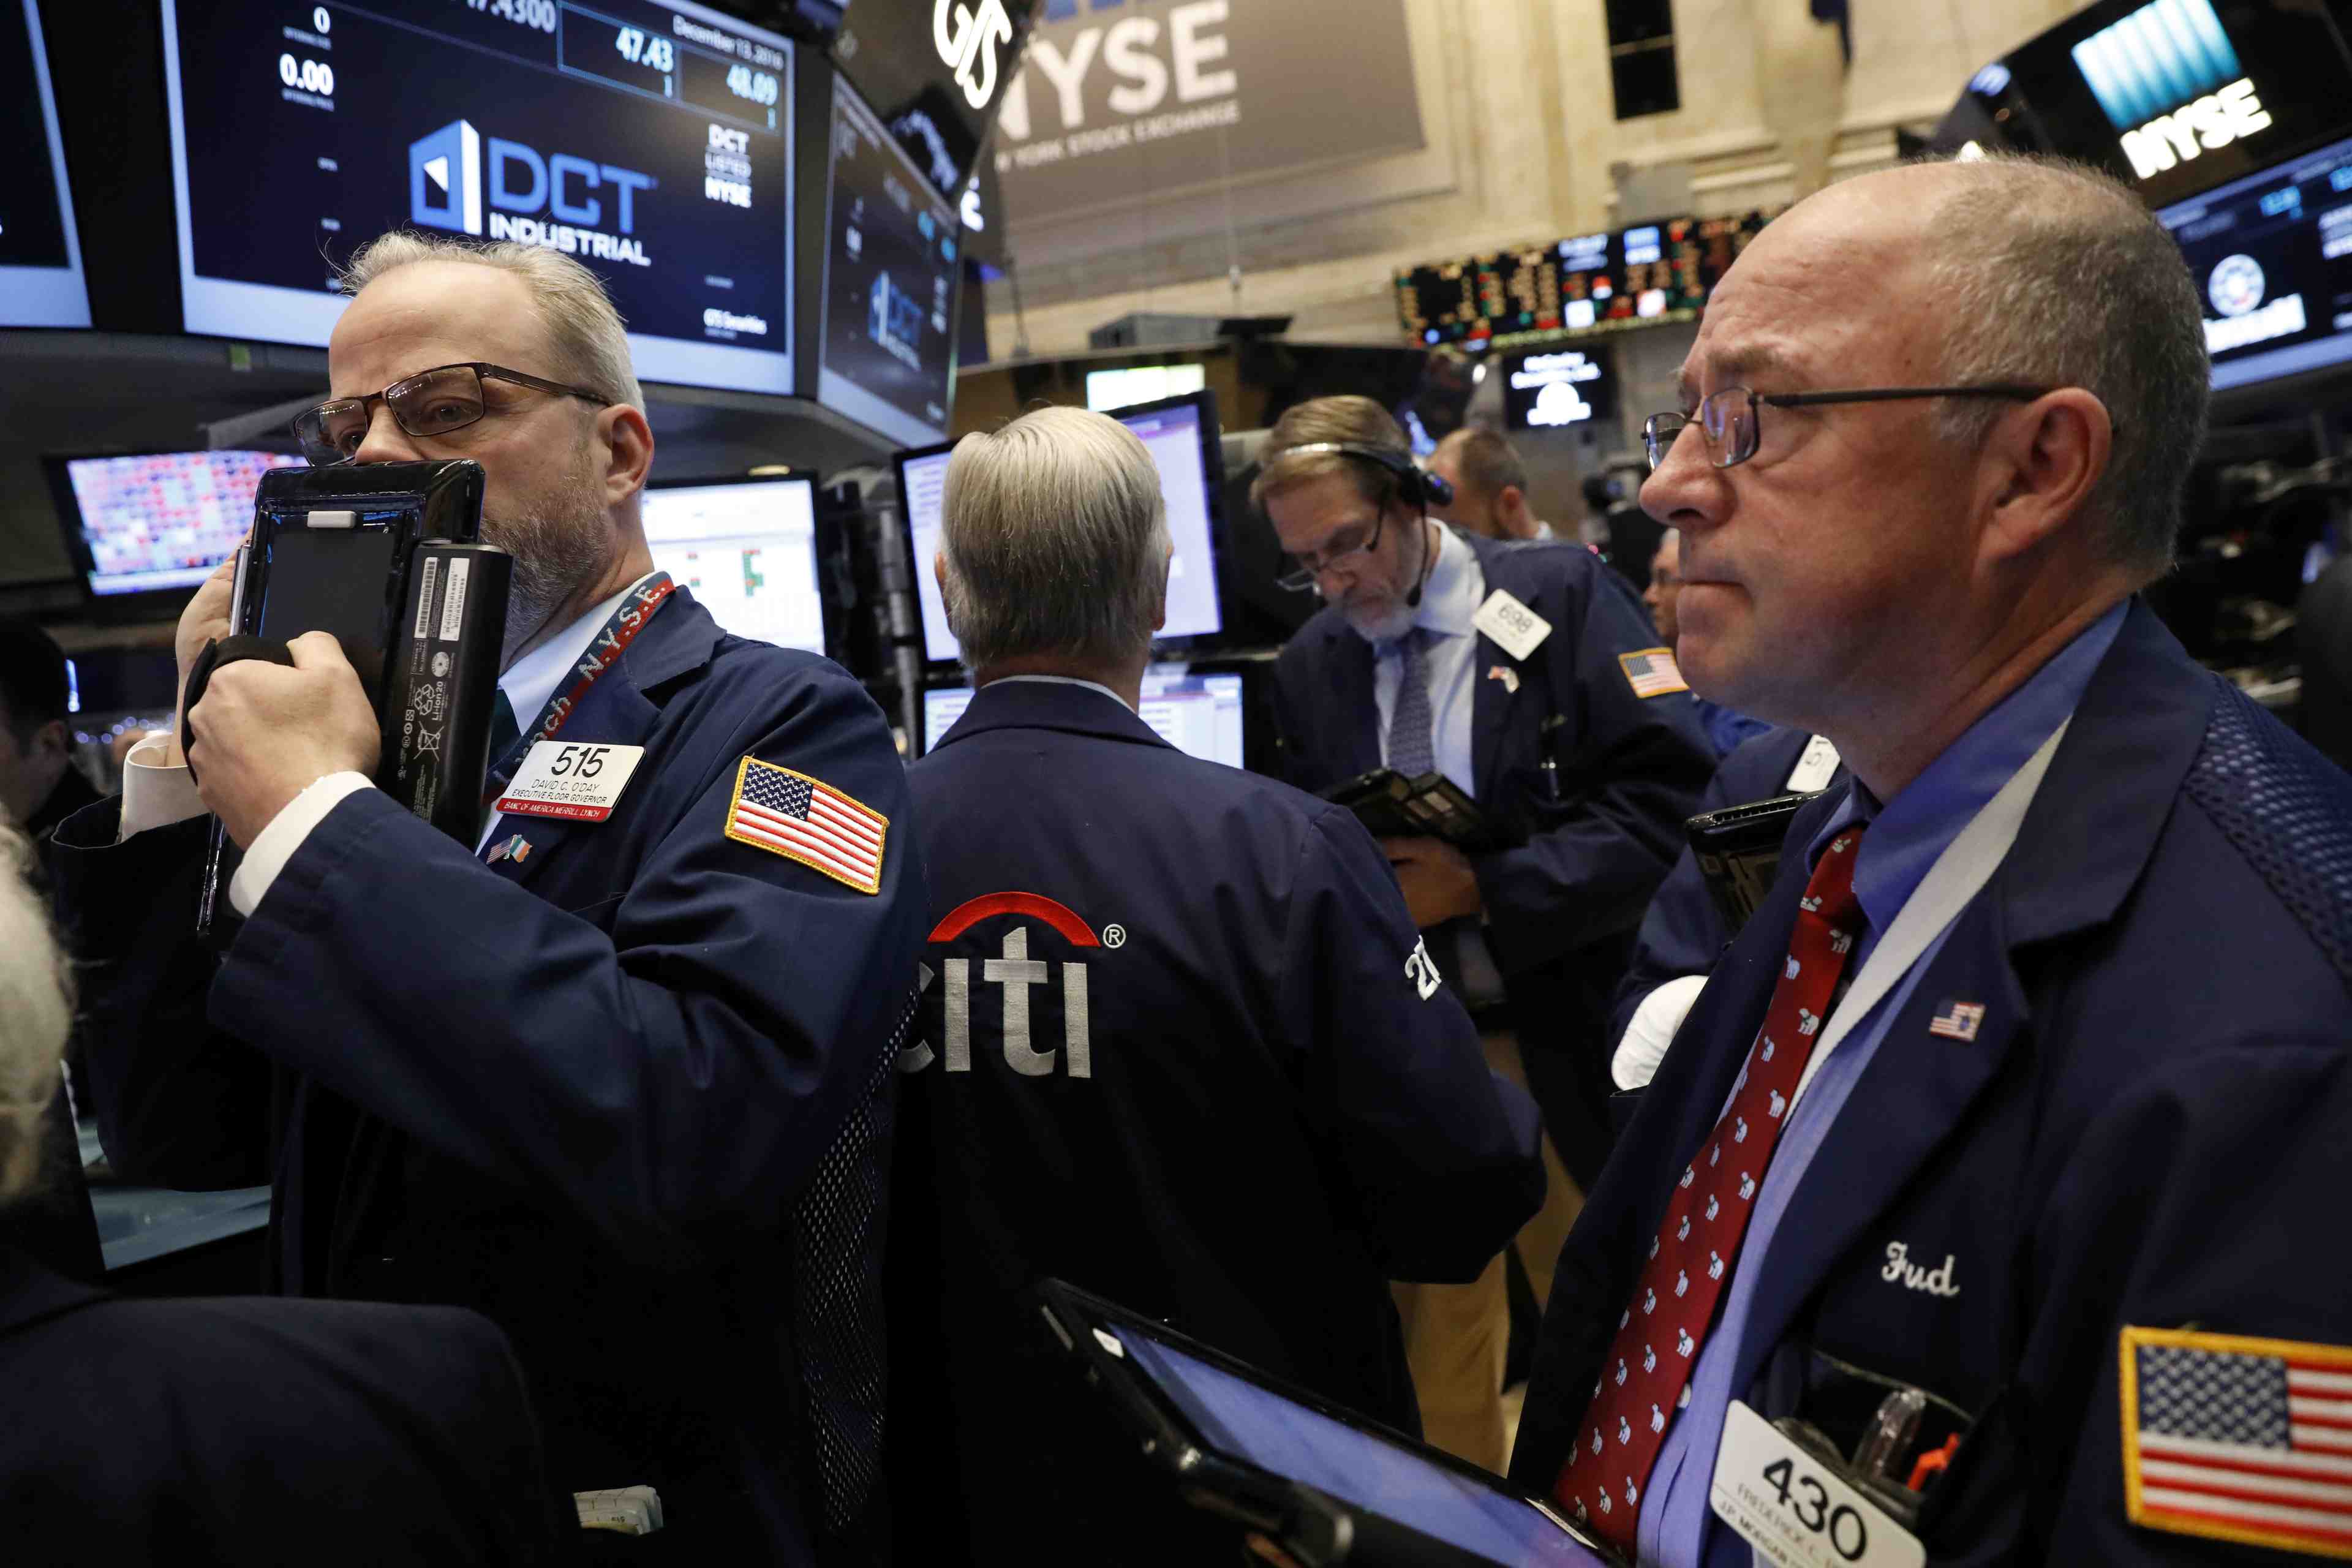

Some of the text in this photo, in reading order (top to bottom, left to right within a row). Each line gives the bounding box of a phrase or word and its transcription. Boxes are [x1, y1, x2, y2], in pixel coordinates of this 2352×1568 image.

[314, 7, 330, 34] 0
[616, 27, 673, 72] 47.43
[279, 53, 333, 96] 0.00
[709, 123, 750, 154] DCT
[2120, 77, 2273, 179] NYSE
[488, 137, 650, 235] DCT
[705, 176, 752, 208] NYSE
[490, 212, 652, 266] INDUSTRIAL
[551, 746, 611, 778] 515
[512, 789, 608, 804] EXECUTIVE FLOOR GOVERNOR
[531, 779, 600, 793] DAVID C. O'DAY
[1881, 1241, 1960, 1296] Fud
[1763, 1458, 1866, 1561] 430
